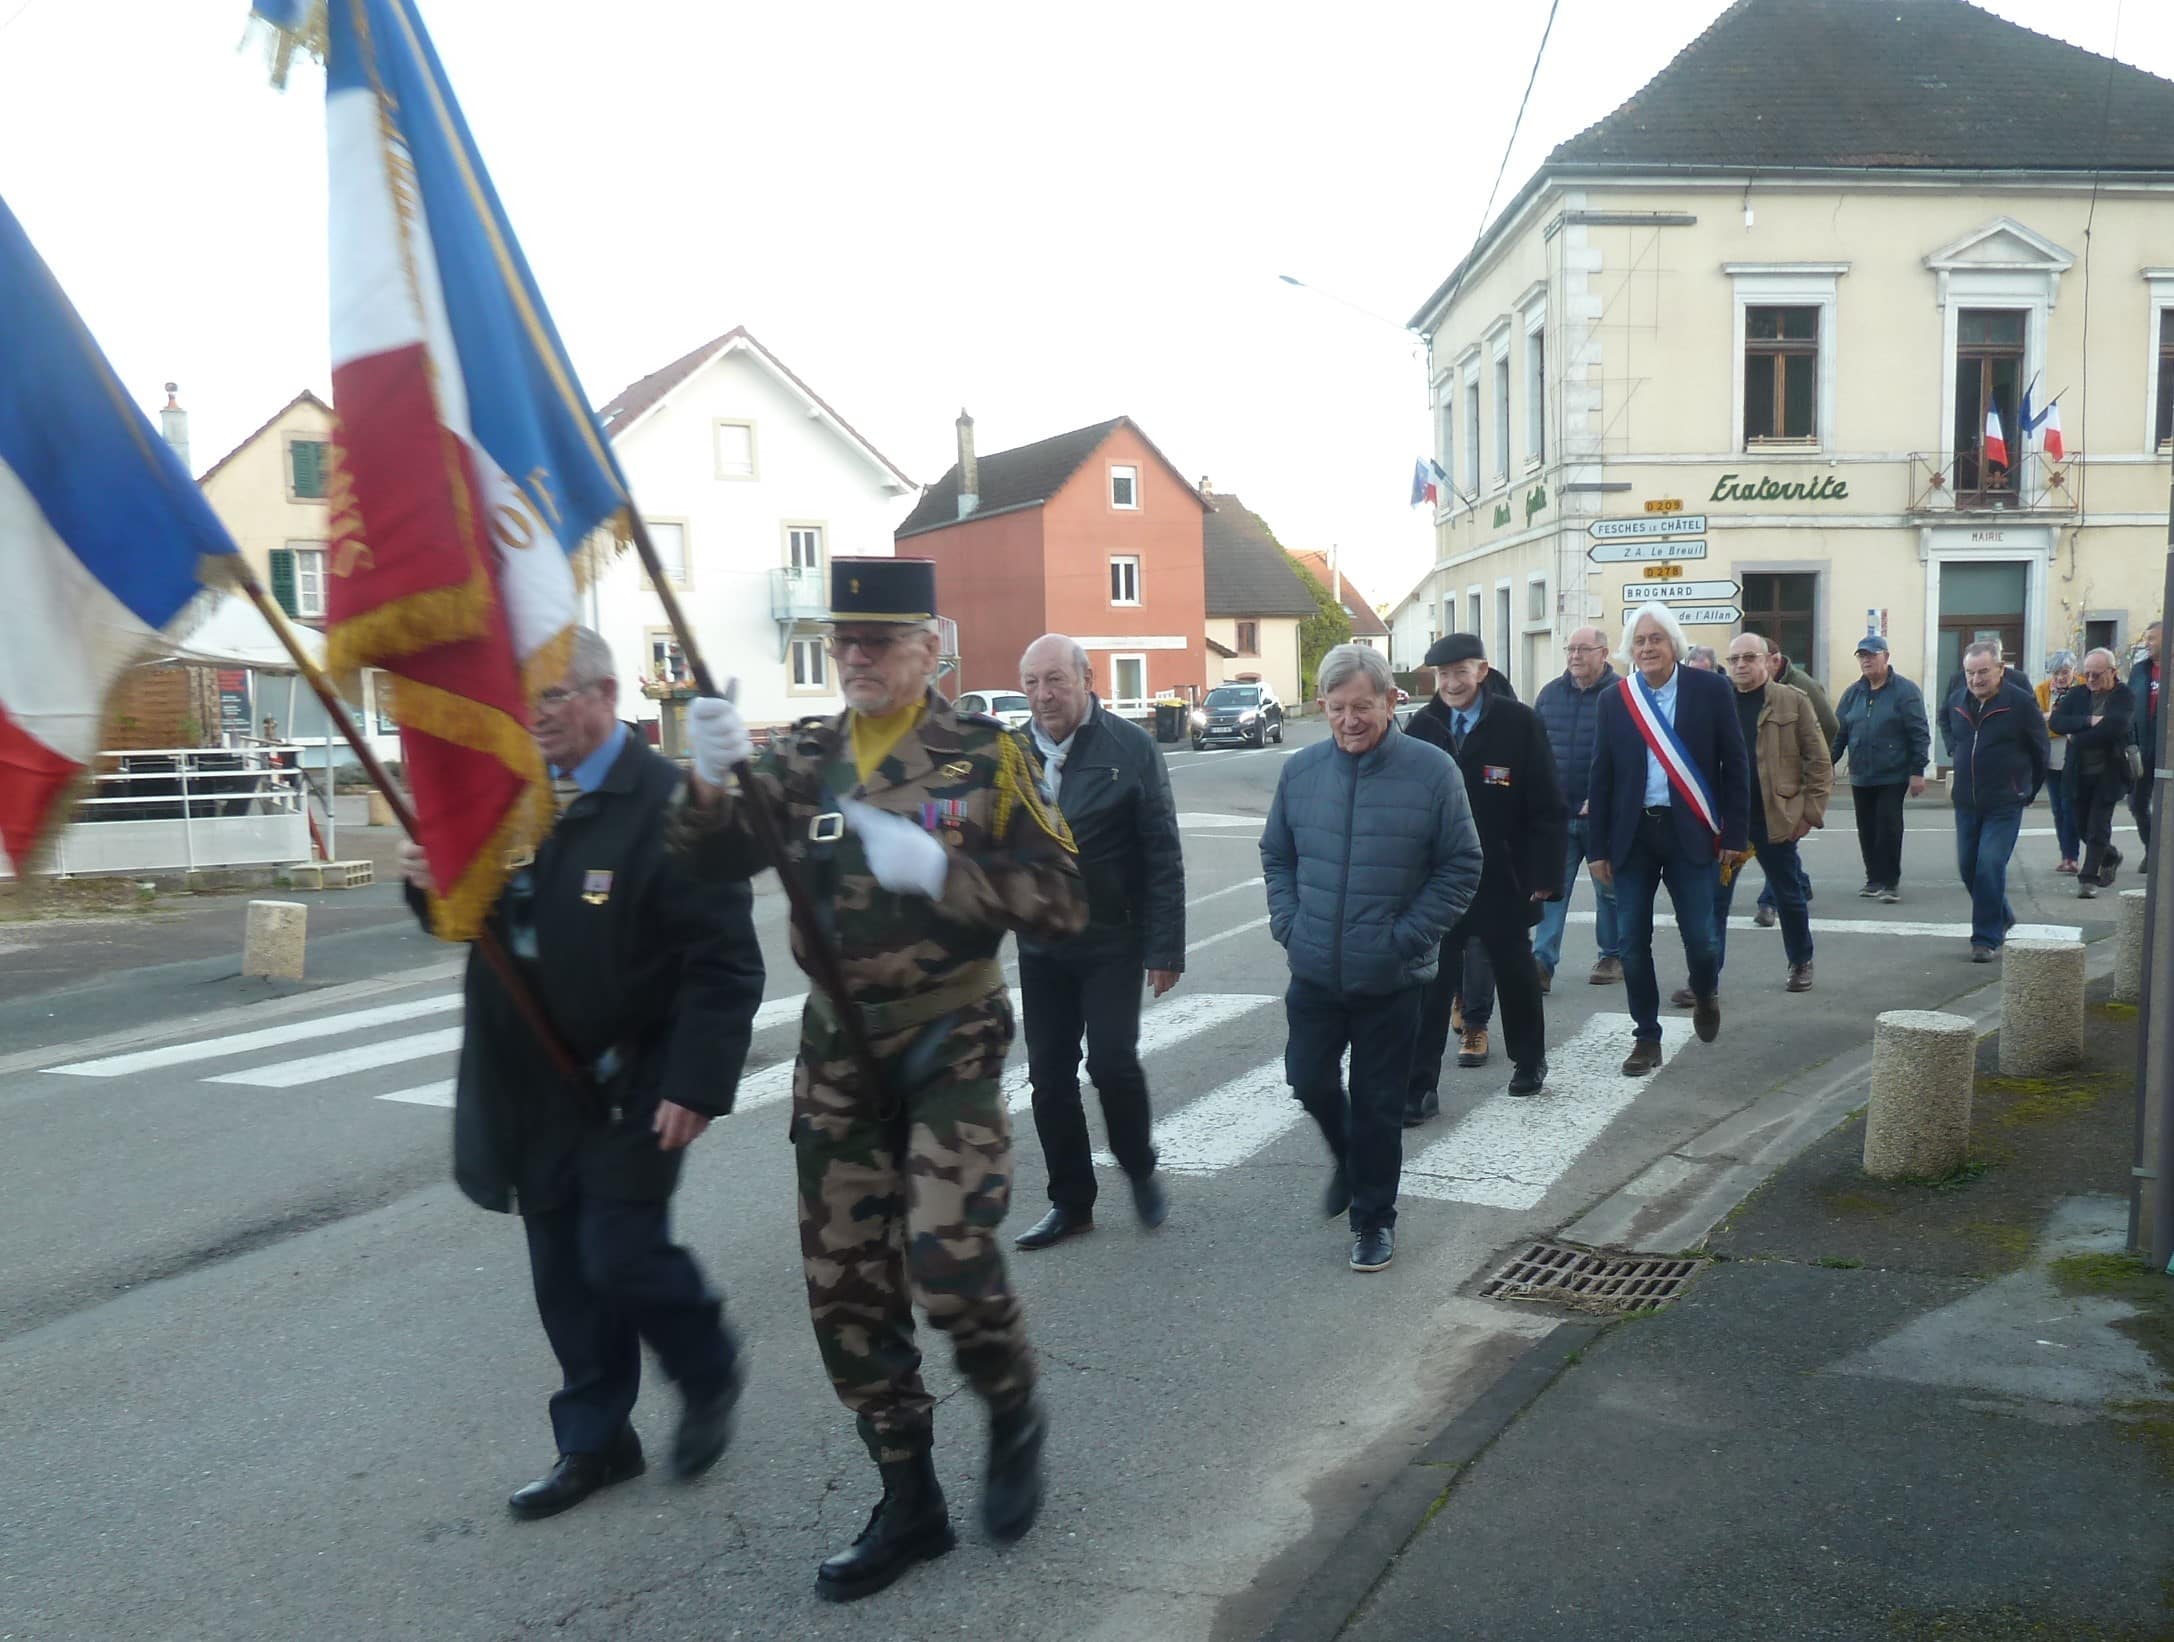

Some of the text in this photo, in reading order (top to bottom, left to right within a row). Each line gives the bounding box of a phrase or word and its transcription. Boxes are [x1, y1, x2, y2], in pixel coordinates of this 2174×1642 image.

[1646, 502, 1654, 512] D
[1598, 523, 1646, 534] FESCHES
[1660, 520, 1702, 531] CHÂTEL
[1971, 532, 2005, 542] MAIRIE
[1651, 546, 1663, 556] Le
[1668, 545, 1704, 556] Breuil
[1646, 567, 1680, 577] D 278
[1627, 586, 1693, 598] BROGNARD
[1679, 610, 1731, 620] de l'Allan
